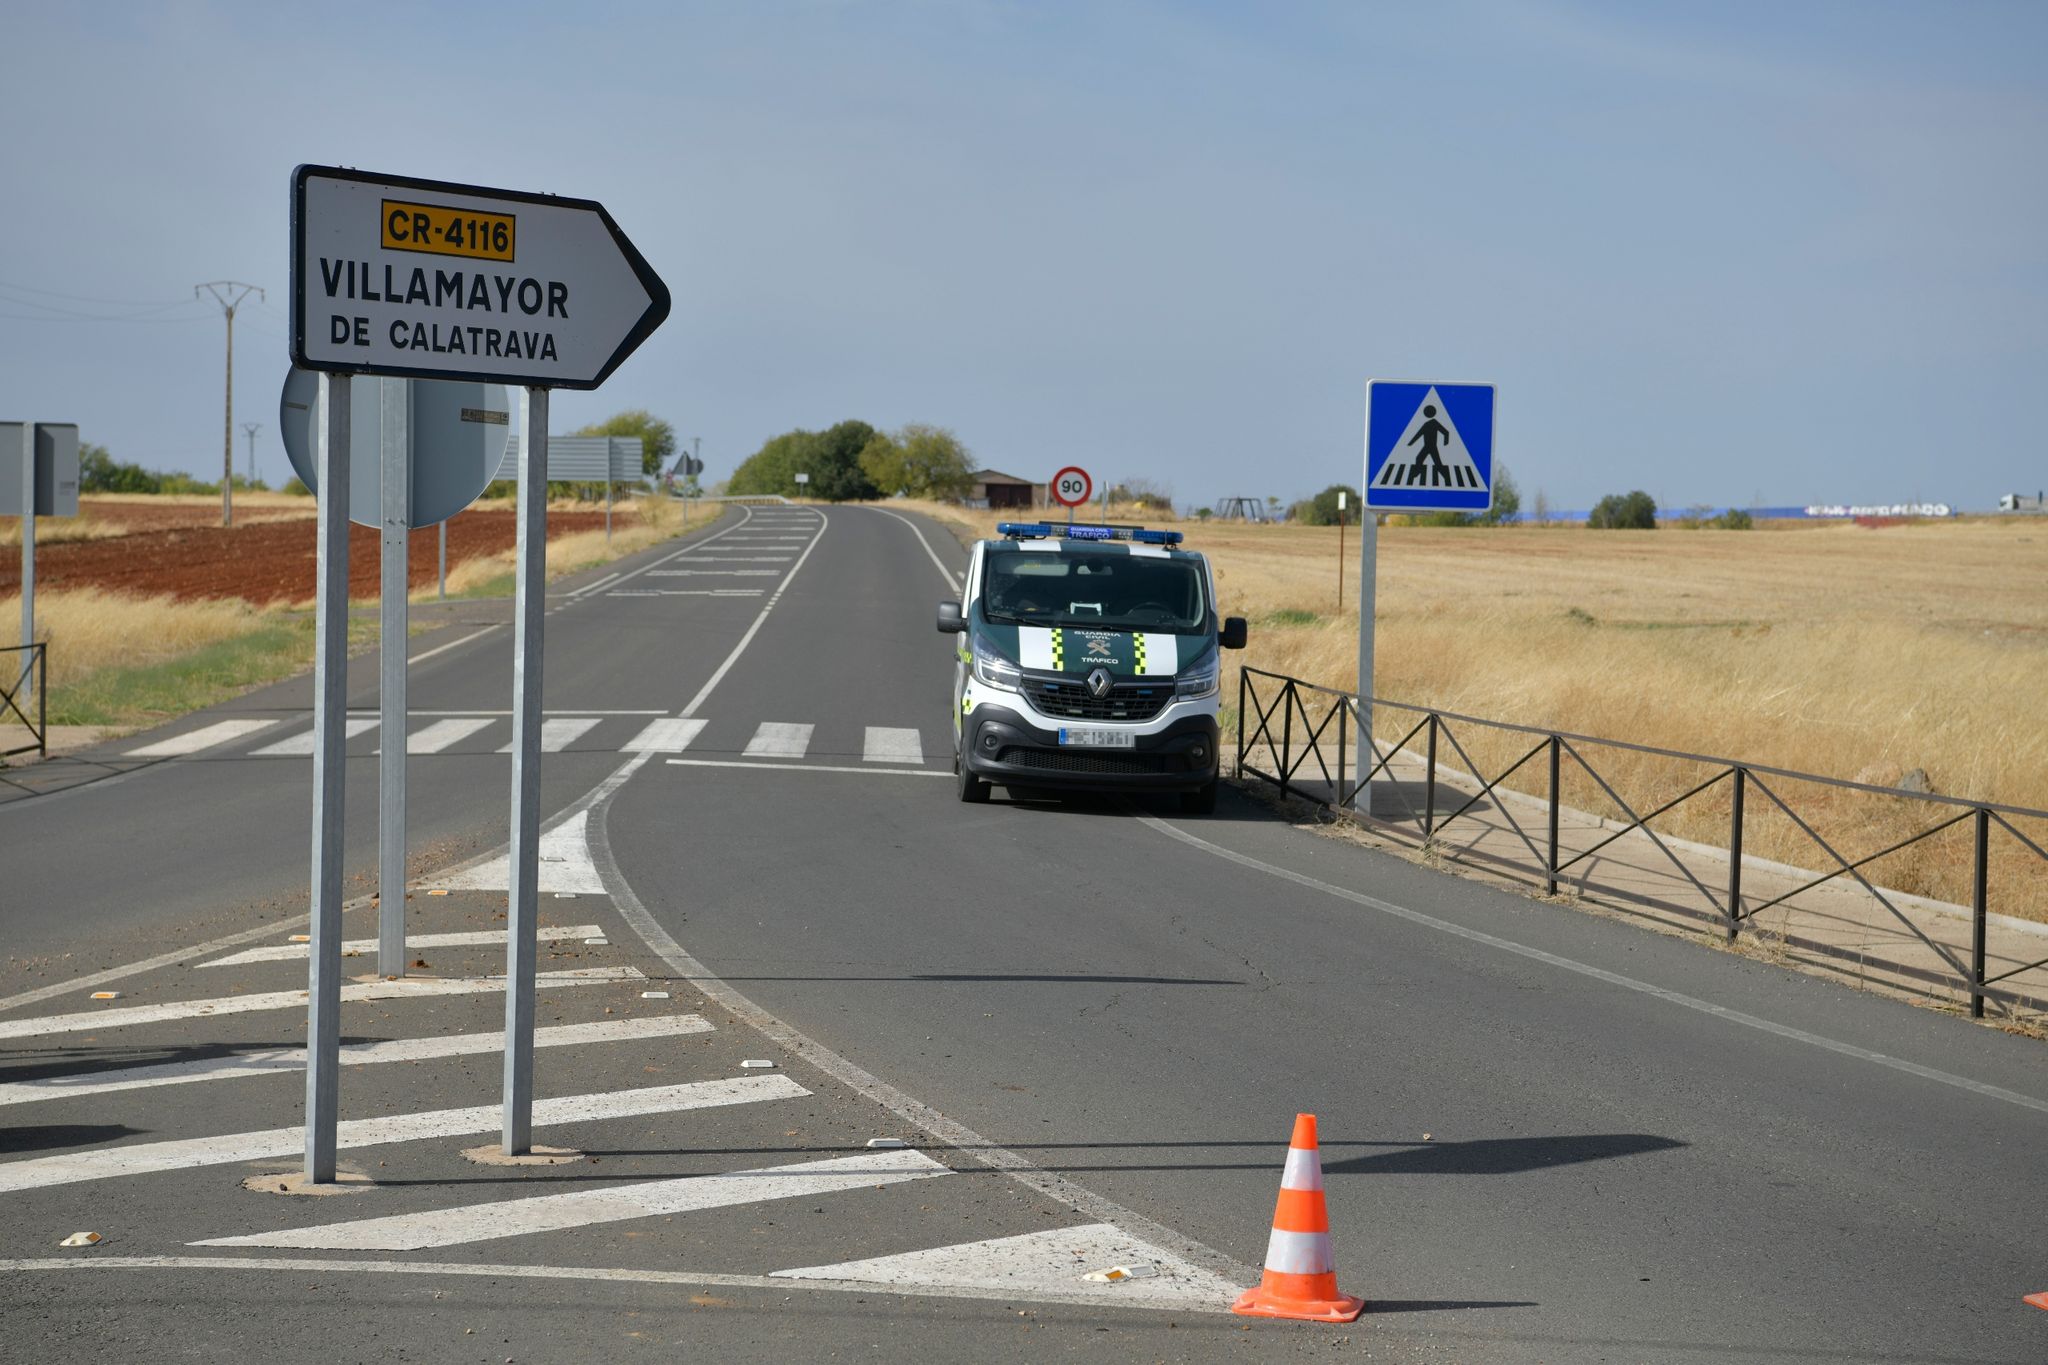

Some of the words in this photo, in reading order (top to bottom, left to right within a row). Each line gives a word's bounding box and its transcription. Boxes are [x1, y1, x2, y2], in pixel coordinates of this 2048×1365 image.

[388, 209, 509, 253] CR-4116
[319, 257, 569, 319] VILLAMAYOR
[331, 315, 370, 347] DE
[389, 319, 558, 361] CALATRAVA
[1062, 480, 1082, 493] 90
